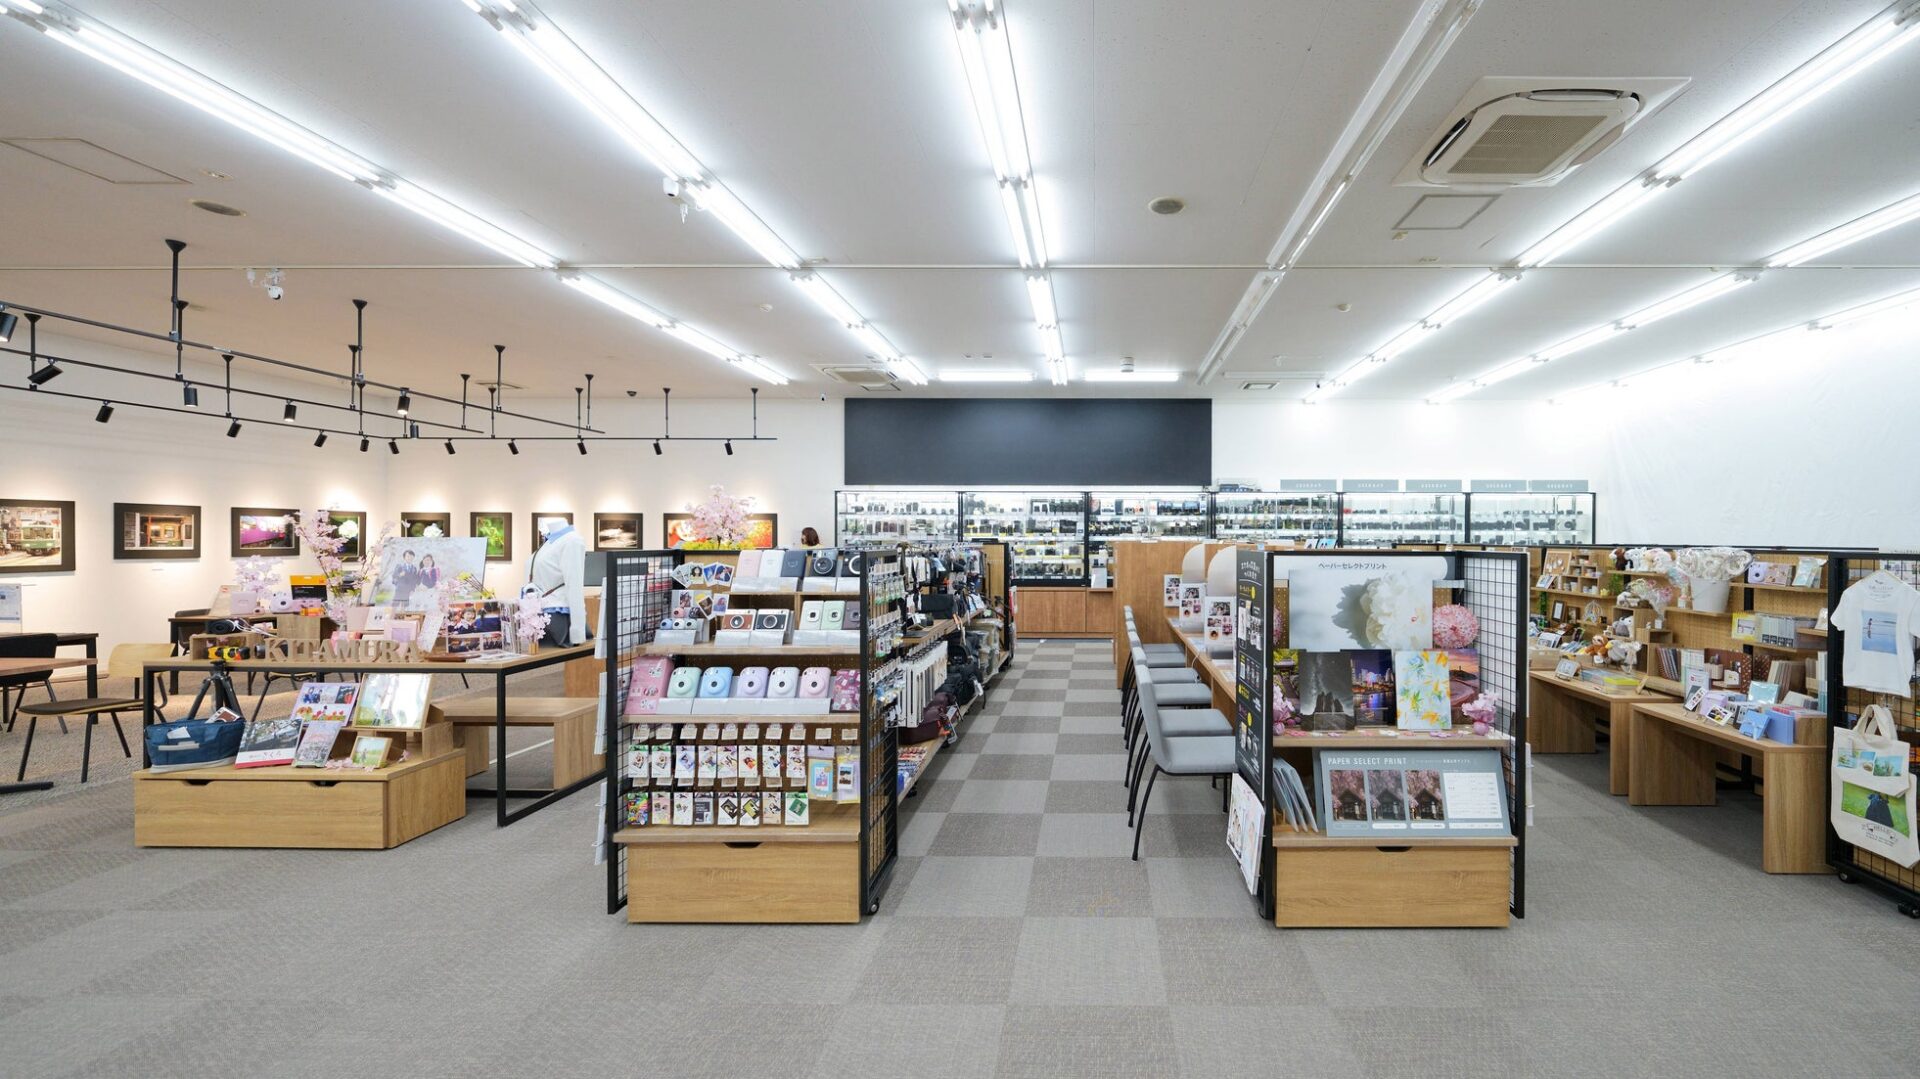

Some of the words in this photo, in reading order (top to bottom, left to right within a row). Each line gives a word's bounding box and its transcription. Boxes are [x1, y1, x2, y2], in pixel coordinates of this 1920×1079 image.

[1318, 562, 1387, 570] ペーパーセレクトプリント
[264, 638, 424, 663] KITAMURA
[1327, 757, 1351, 765] PAPER
[1353, 757, 1380, 765] SELECT
[1384, 757, 1407, 765] PRINT
